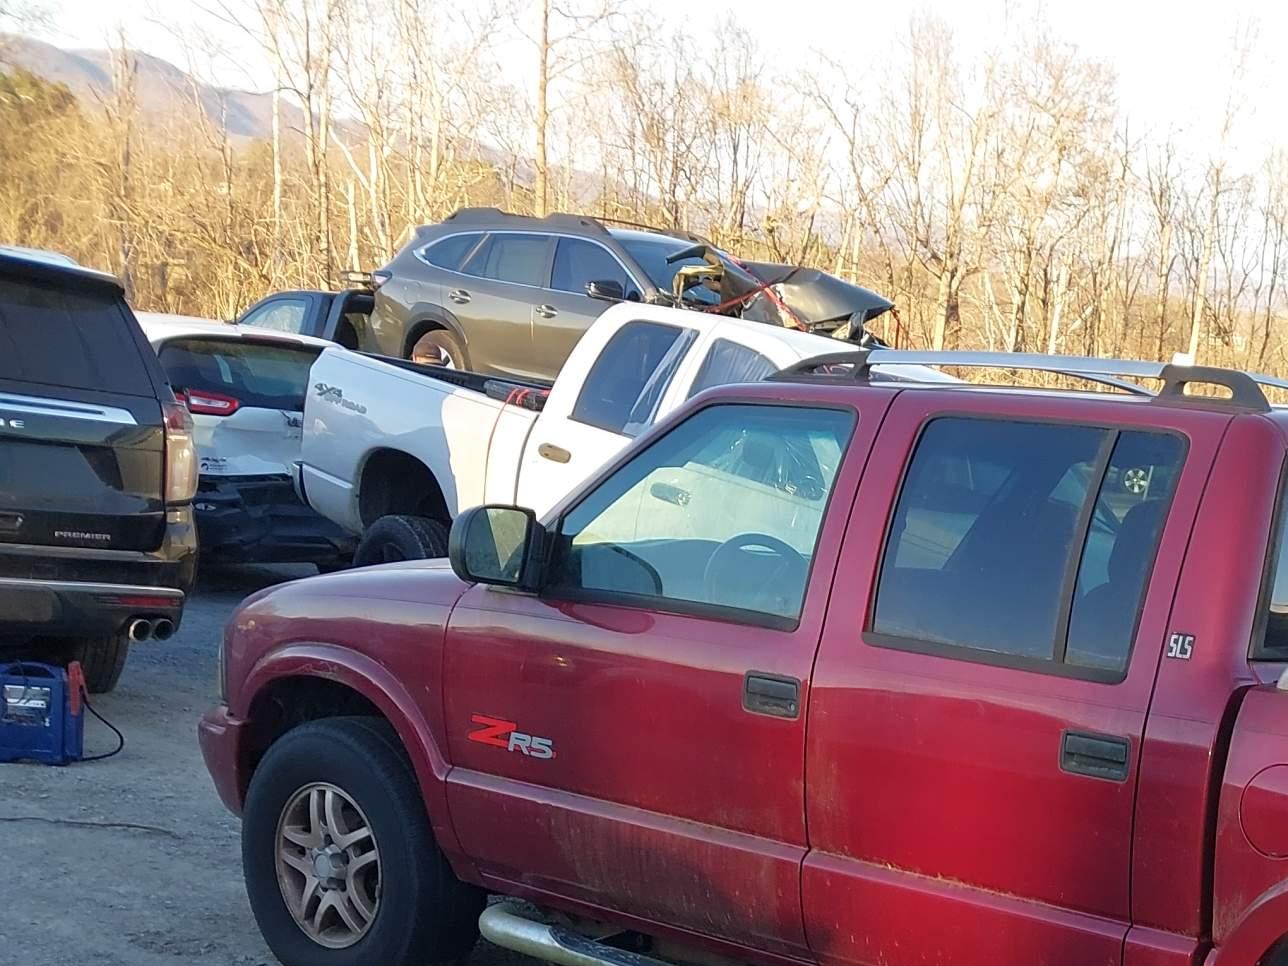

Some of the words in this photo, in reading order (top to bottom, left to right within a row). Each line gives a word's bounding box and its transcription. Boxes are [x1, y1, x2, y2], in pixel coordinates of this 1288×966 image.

[54, 530, 112, 541] PREMIER
[1167, 634, 1194, 659] SLS
[468, 714, 555, 759] ZR5
